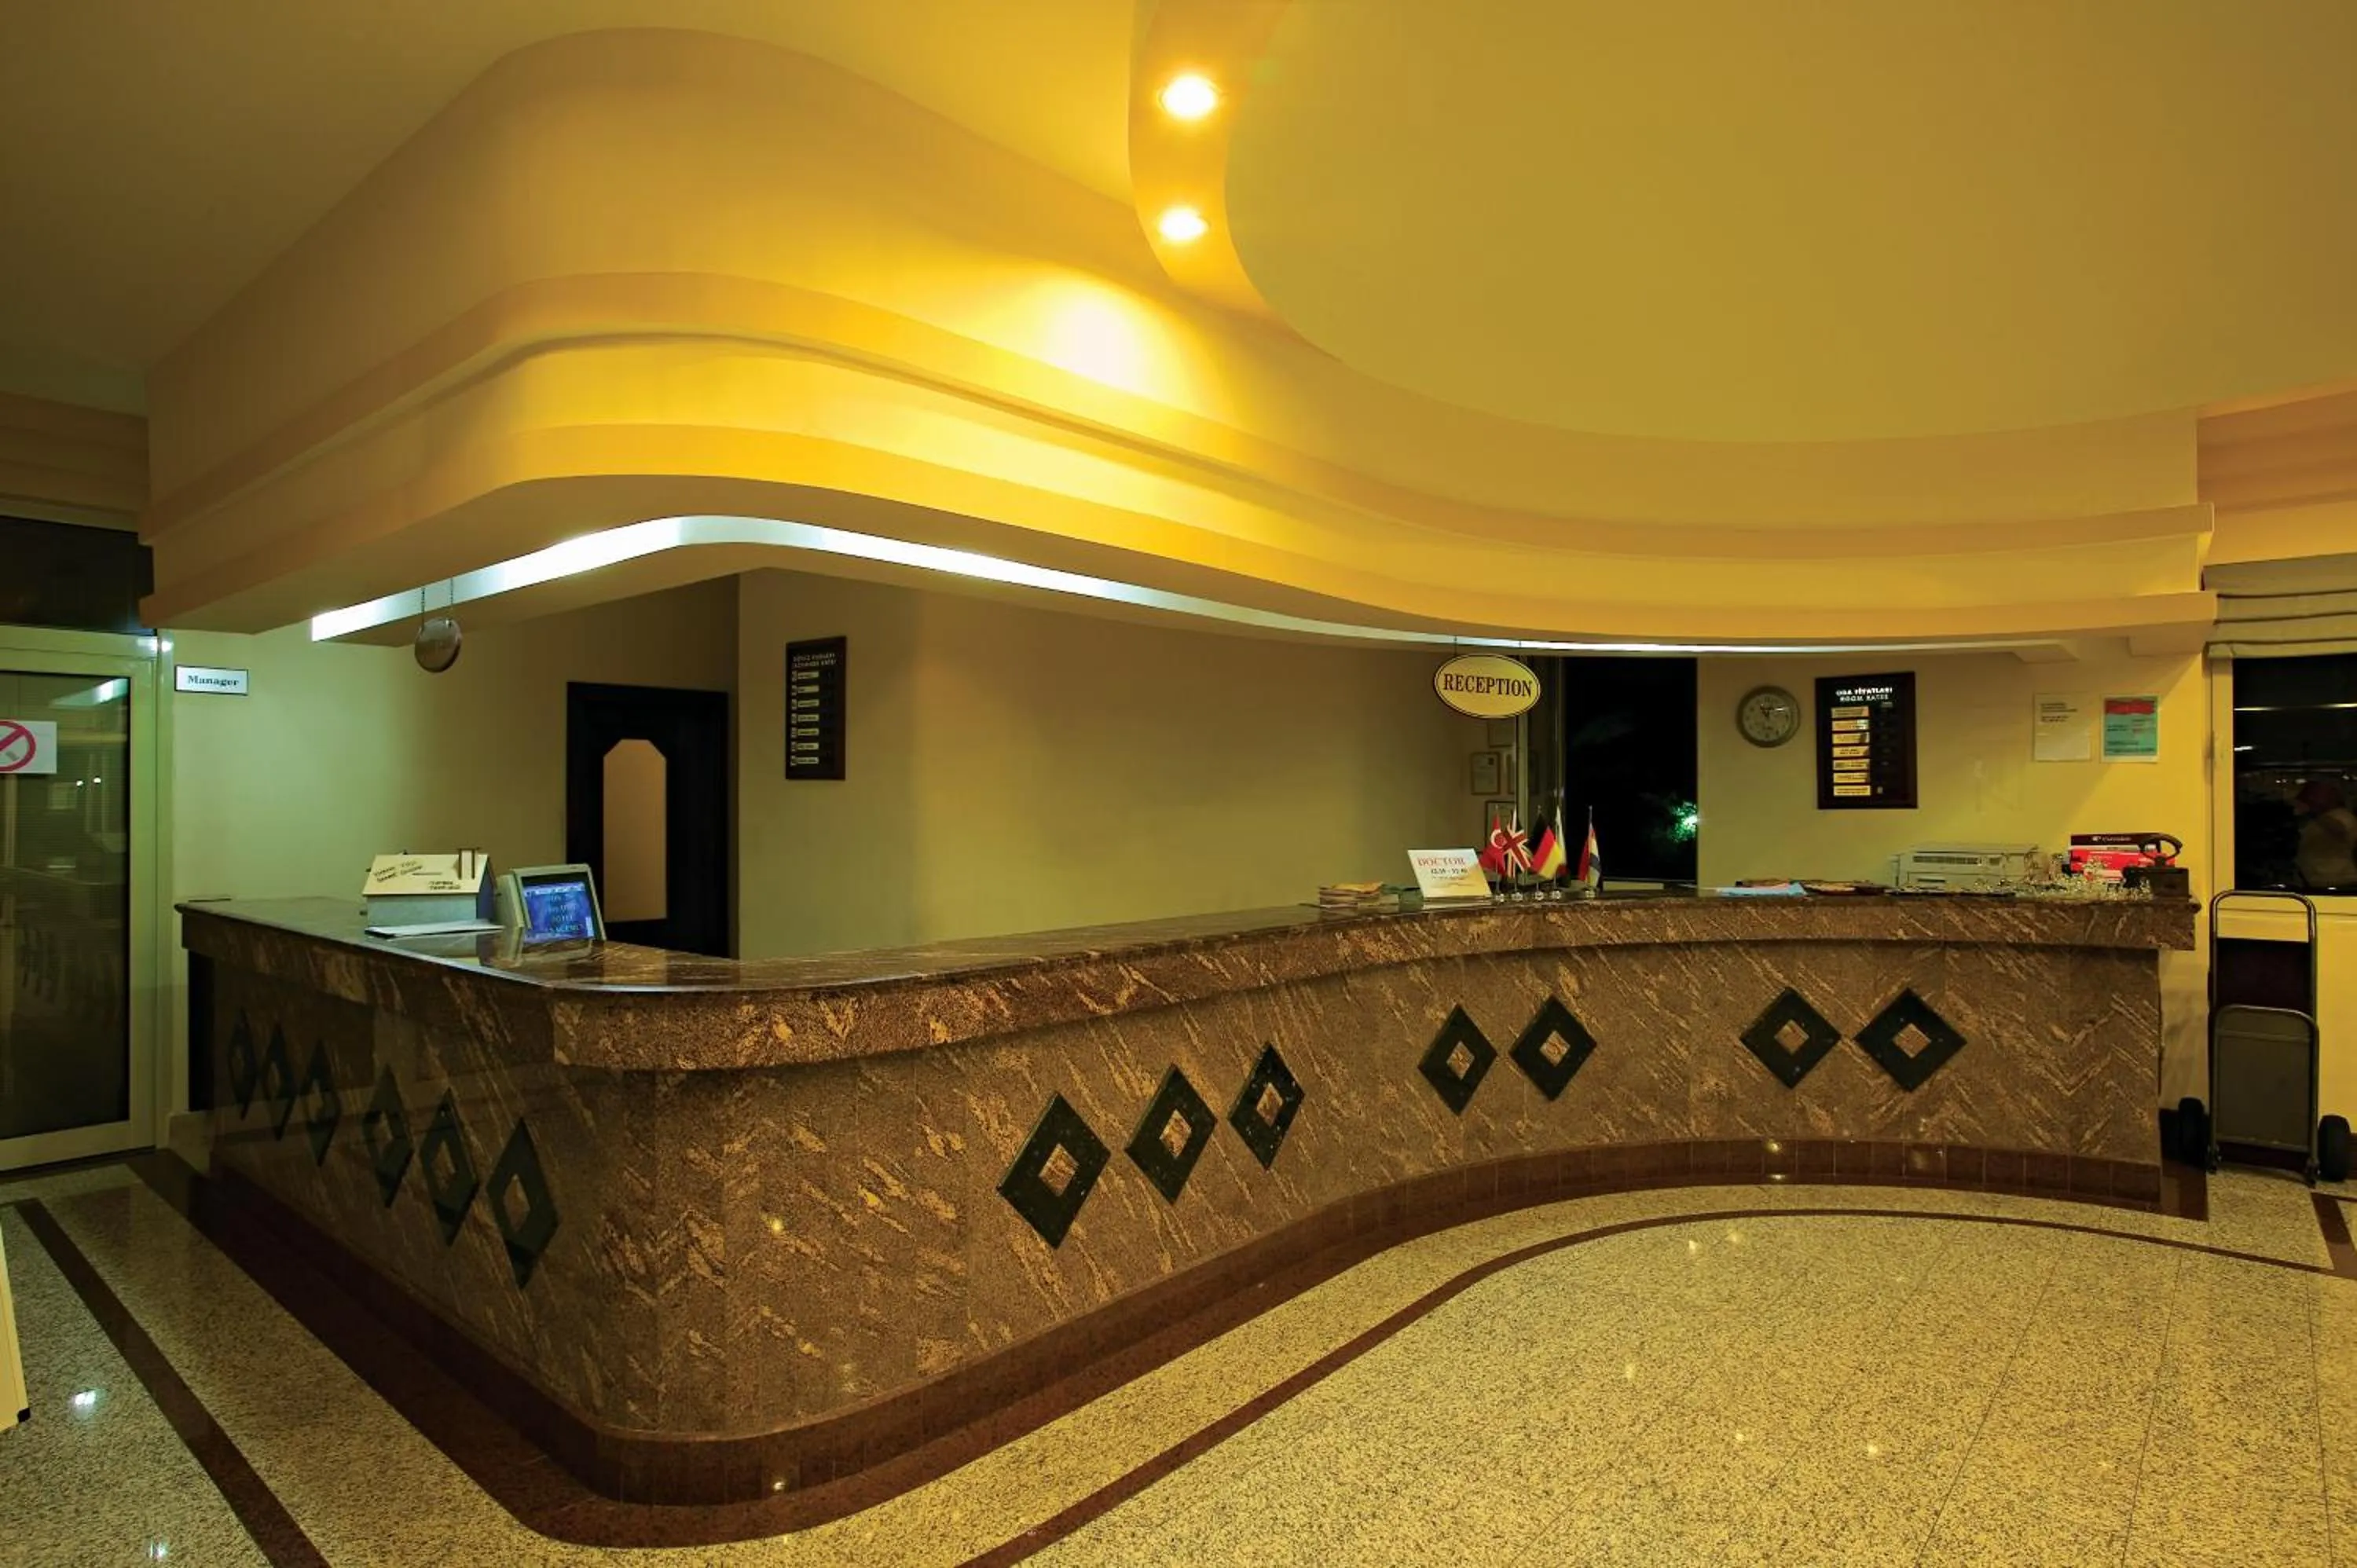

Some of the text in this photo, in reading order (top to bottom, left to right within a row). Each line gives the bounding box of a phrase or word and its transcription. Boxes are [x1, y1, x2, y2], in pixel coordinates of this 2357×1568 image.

[188, 675, 240, 687] Manager
[1442, 673, 1532, 698] RECEPTION
[1417, 856, 1466, 866] DOCTOR
